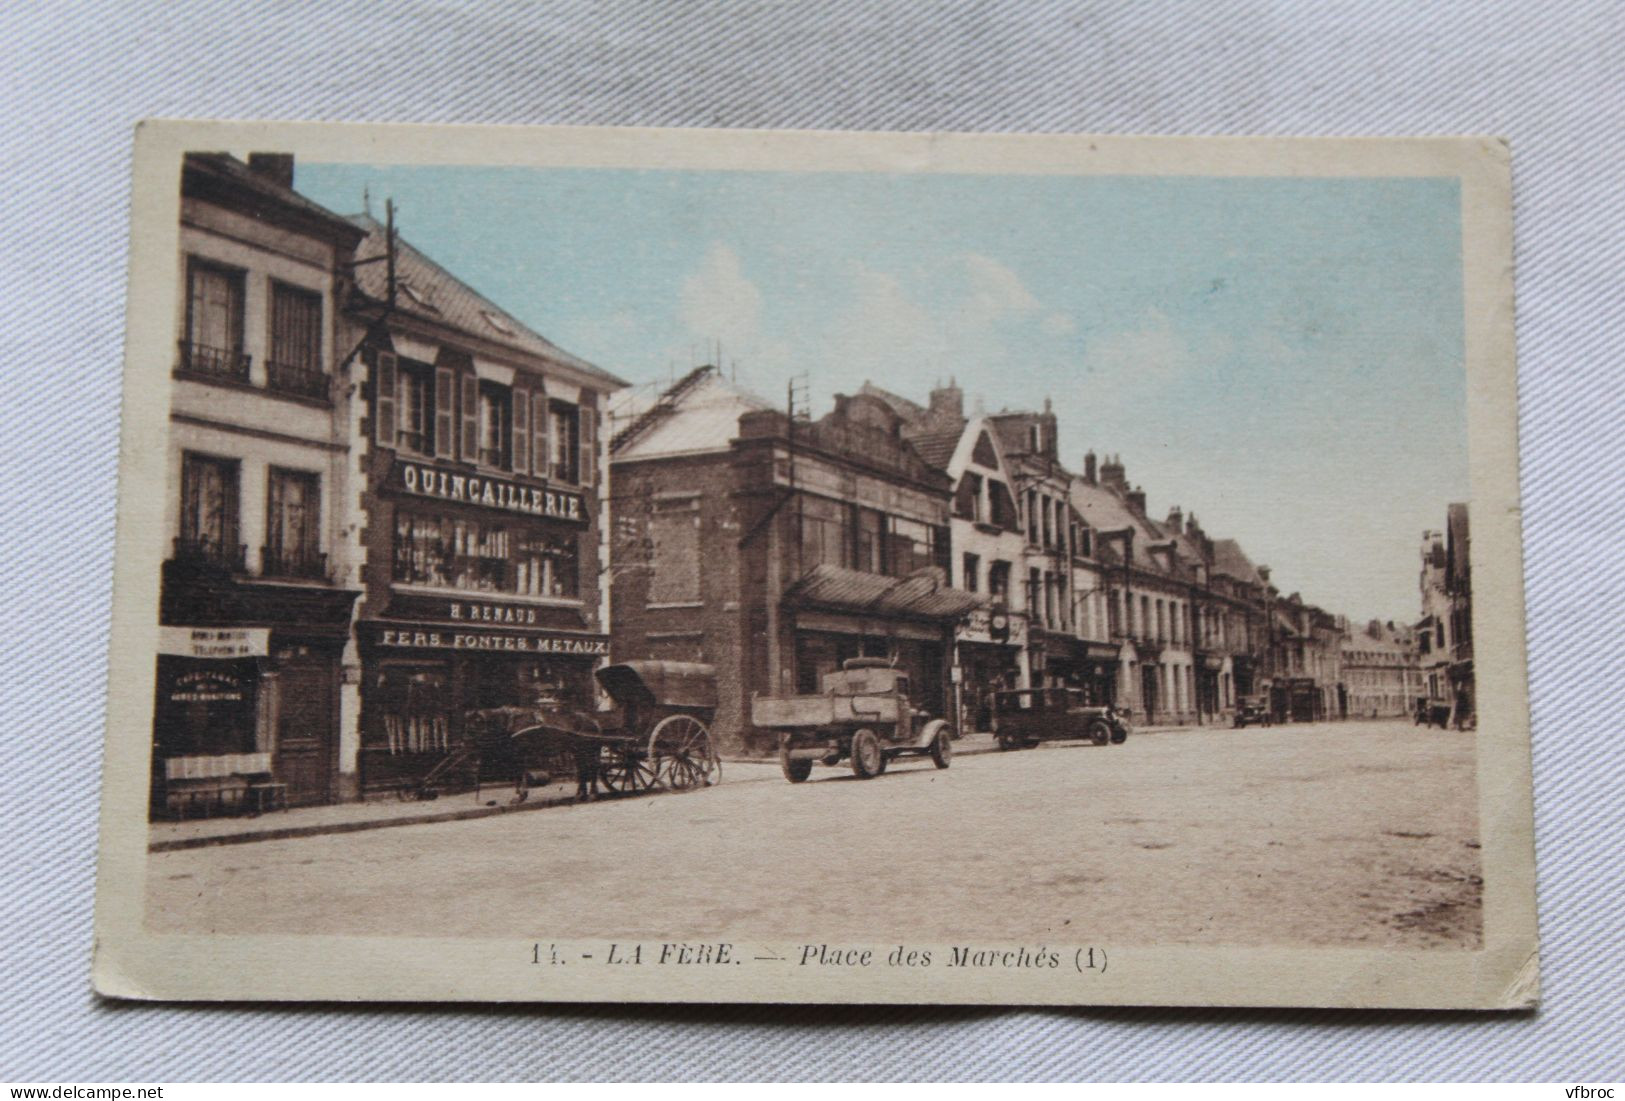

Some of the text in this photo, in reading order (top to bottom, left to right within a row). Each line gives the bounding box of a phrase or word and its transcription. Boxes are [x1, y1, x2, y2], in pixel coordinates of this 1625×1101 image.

[404, 465, 579, 520] QUINCAILLERIE
[471, 605, 536, 624] RENAUD
[382, 631, 441, 647] FERS
[454, 634, 527, 650] FONTES
[606, 943, 643, 965] LA
[799, 944, 872, 967] Place
[888, 946, 932, 967] des
[947, 947, 1059, 969] Marchés
[1075, 947, 1108, 973] (1)
